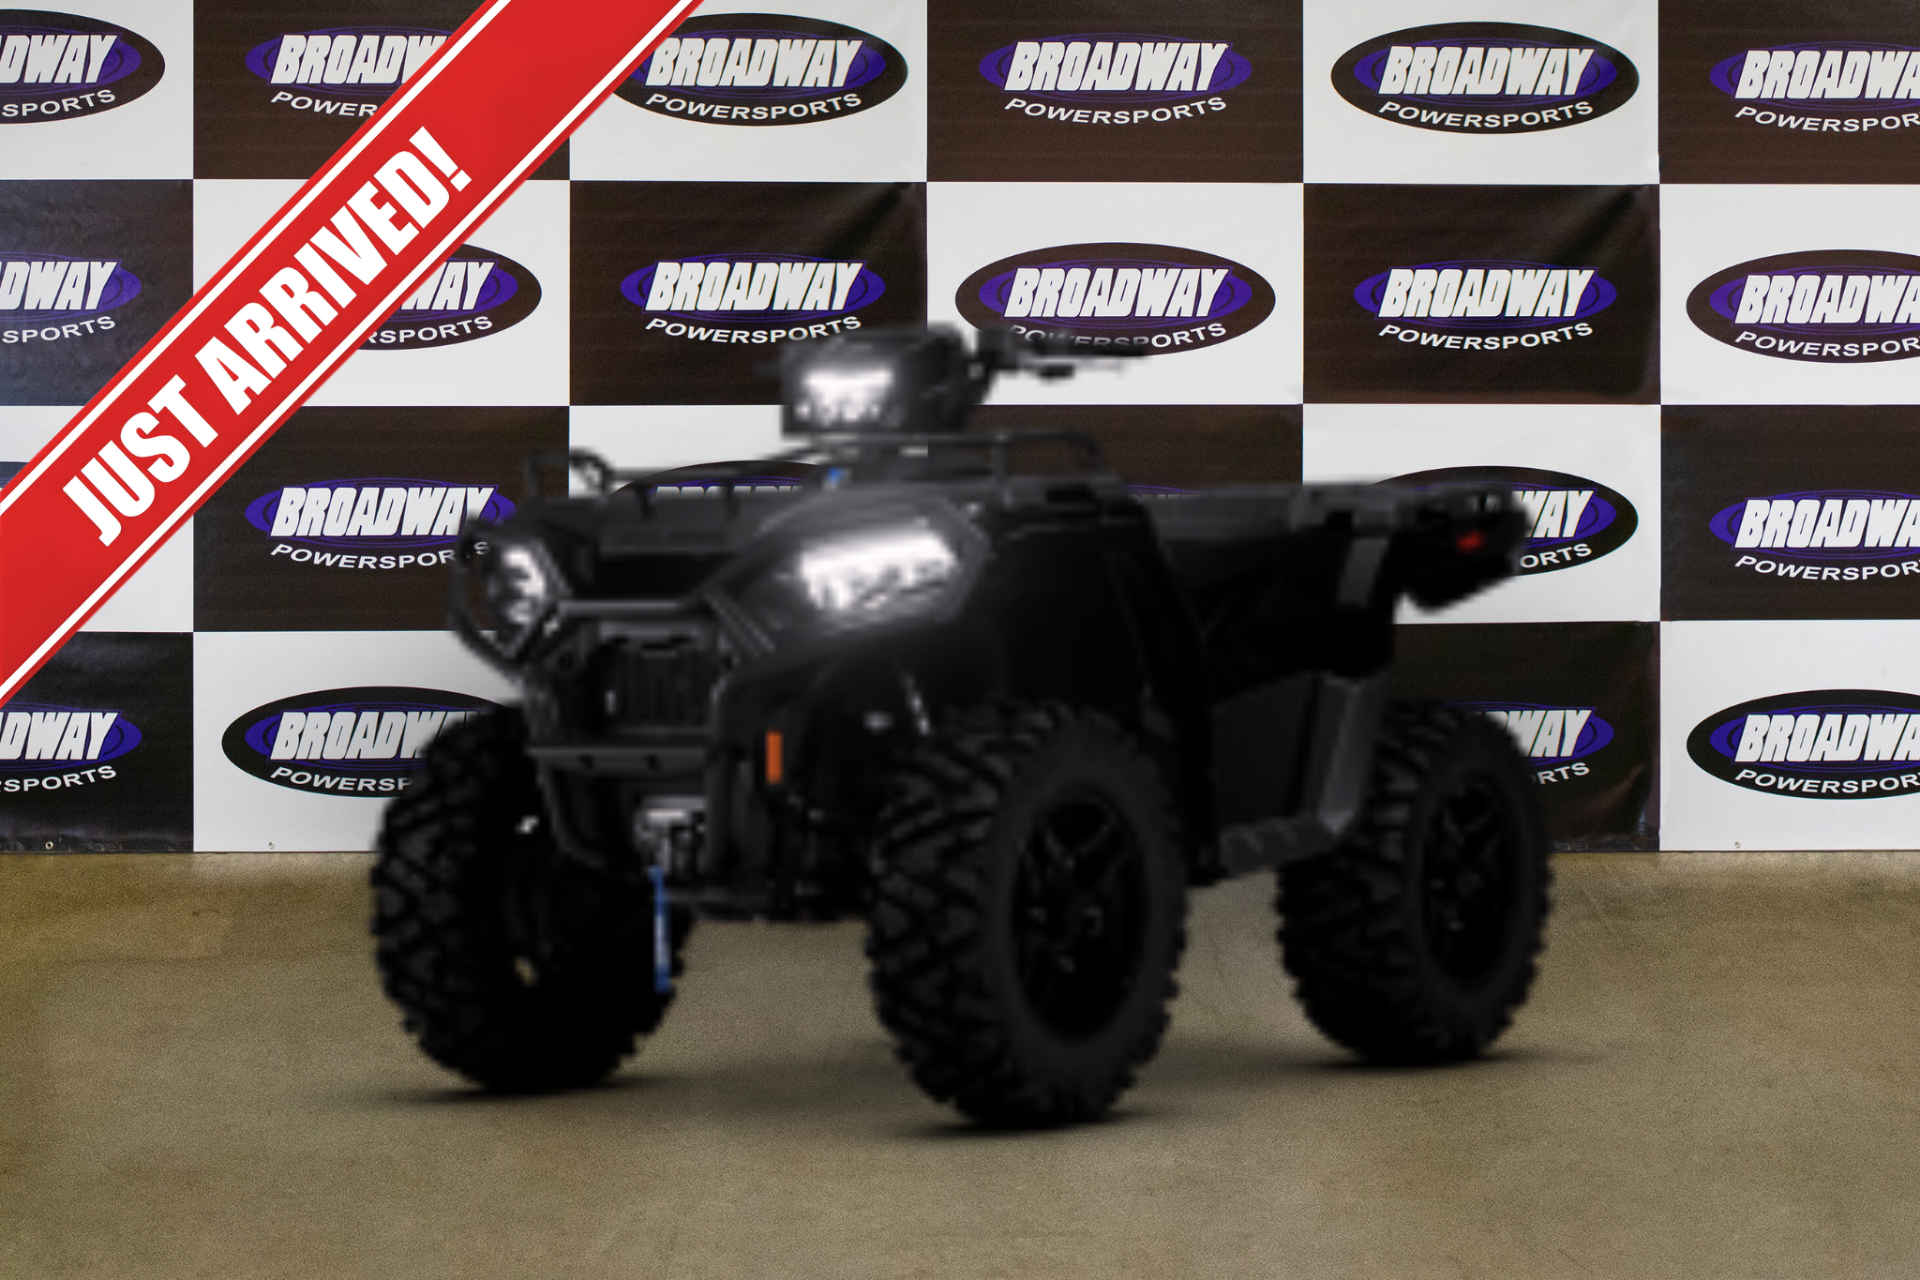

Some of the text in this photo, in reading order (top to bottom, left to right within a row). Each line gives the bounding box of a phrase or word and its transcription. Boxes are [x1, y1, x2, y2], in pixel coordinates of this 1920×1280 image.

[0, 34, 118, 84] DWAY
[270, 34, 448, 85] BROADW
[645, 37, 863, 88] BROADWAY
[1004, 42, 1229, 92] BROADWAY
[1379, 46, 1594, 96] BROADWAY
[645, 93, 862, 120] POWERSPORTS
[1004, 97, 1227, 124] POWERSPORTS
[1379, 101, 1593, 128] POWERSPORTS
[1734, 106, 1920, 132] POWERSPOR
[0, 261, 118, 310] DWAY
[645, 262, 863, 311] BROADWAY
[1004, 268, 1229, 317] BROADWAY
[1379, 269, 1594, 317] BROADWAY
[645, 317, 862, 343] POWERSPORTS
[1379, 323, 1593, 349] POWERSPORTS
[1734, 331, 1920, 357] POWERSPOR
[270, 541, 491, 569] POWERSPORS
[1734, 555, 1920, 581] POWERSPOR
[0, 712, 119, 760] DWAY
[270, 711, 484, 760] BROADW
[0, 765, 117, 793] SPORTS
[270, 767, 413, 791] POWERSP
[1734, 769, 1920, 793] POWERSPOR
